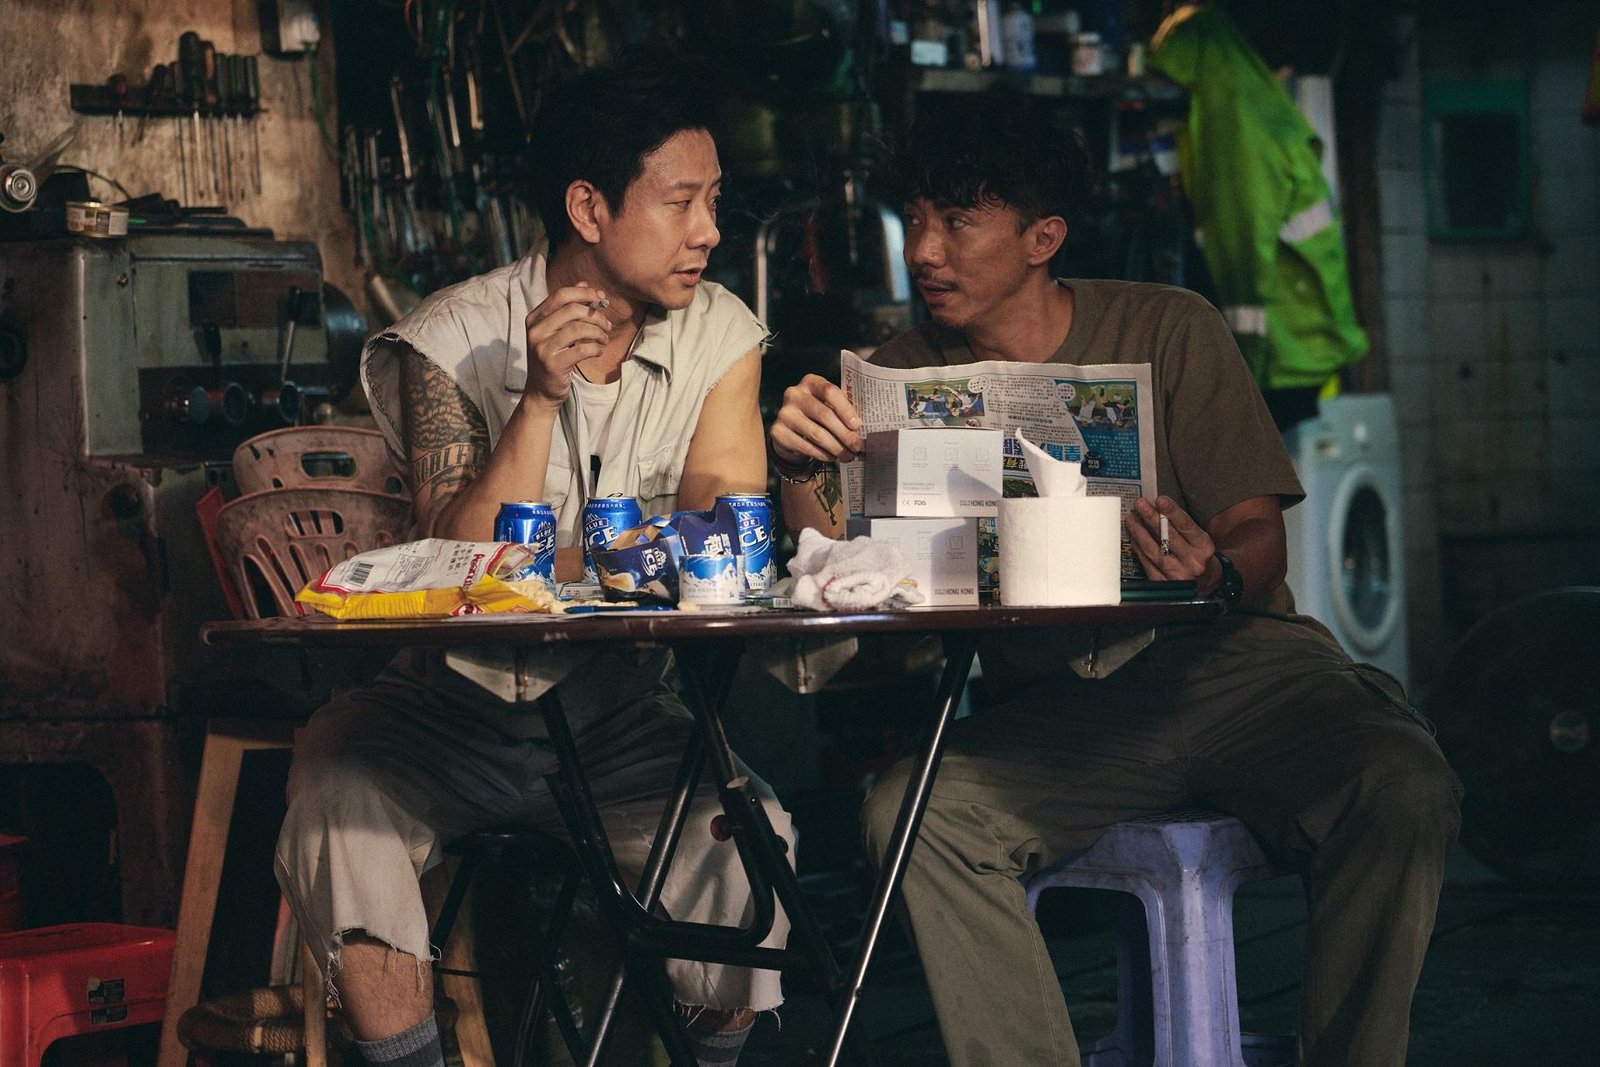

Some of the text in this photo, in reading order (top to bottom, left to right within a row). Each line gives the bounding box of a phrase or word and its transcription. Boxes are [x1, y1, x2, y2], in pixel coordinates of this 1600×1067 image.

[970, 499, 984, 507] HONG
[985, 499, 998, 507] KON
[586, 520, 603, 533] BLUE
[739, 525, 767, 547] CE
[533, 534, 555, 554] CE
[644, 549, 657, 575] ICE
